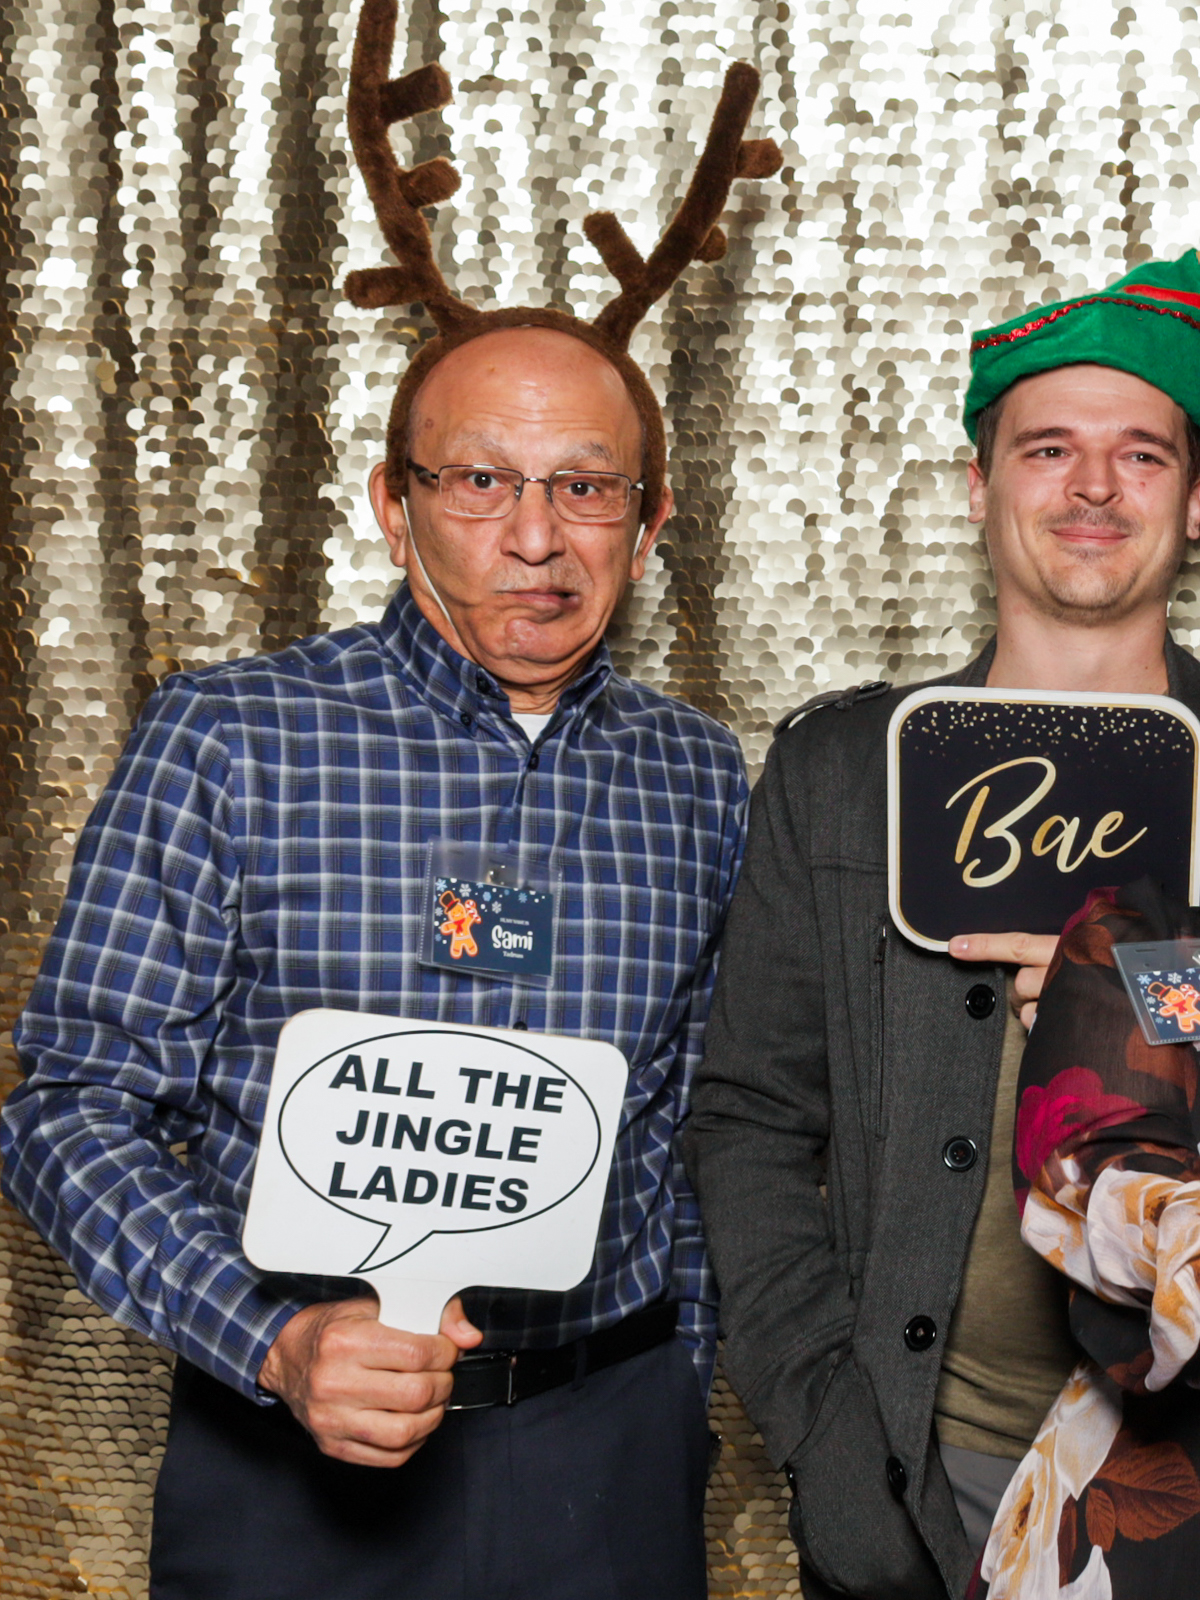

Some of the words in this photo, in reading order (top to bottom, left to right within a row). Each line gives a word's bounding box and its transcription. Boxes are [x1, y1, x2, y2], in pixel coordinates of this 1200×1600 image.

[945, 756, 1148, 888] Bae
[491, 924, 533, 951] Sami
[328, 1054, 436, 1100] ALL
[458, 1066, 568, 1114] THE
[335, 1109, 543, 1164] JINGLE
[327, 1161, 530, 1214] LADIES
